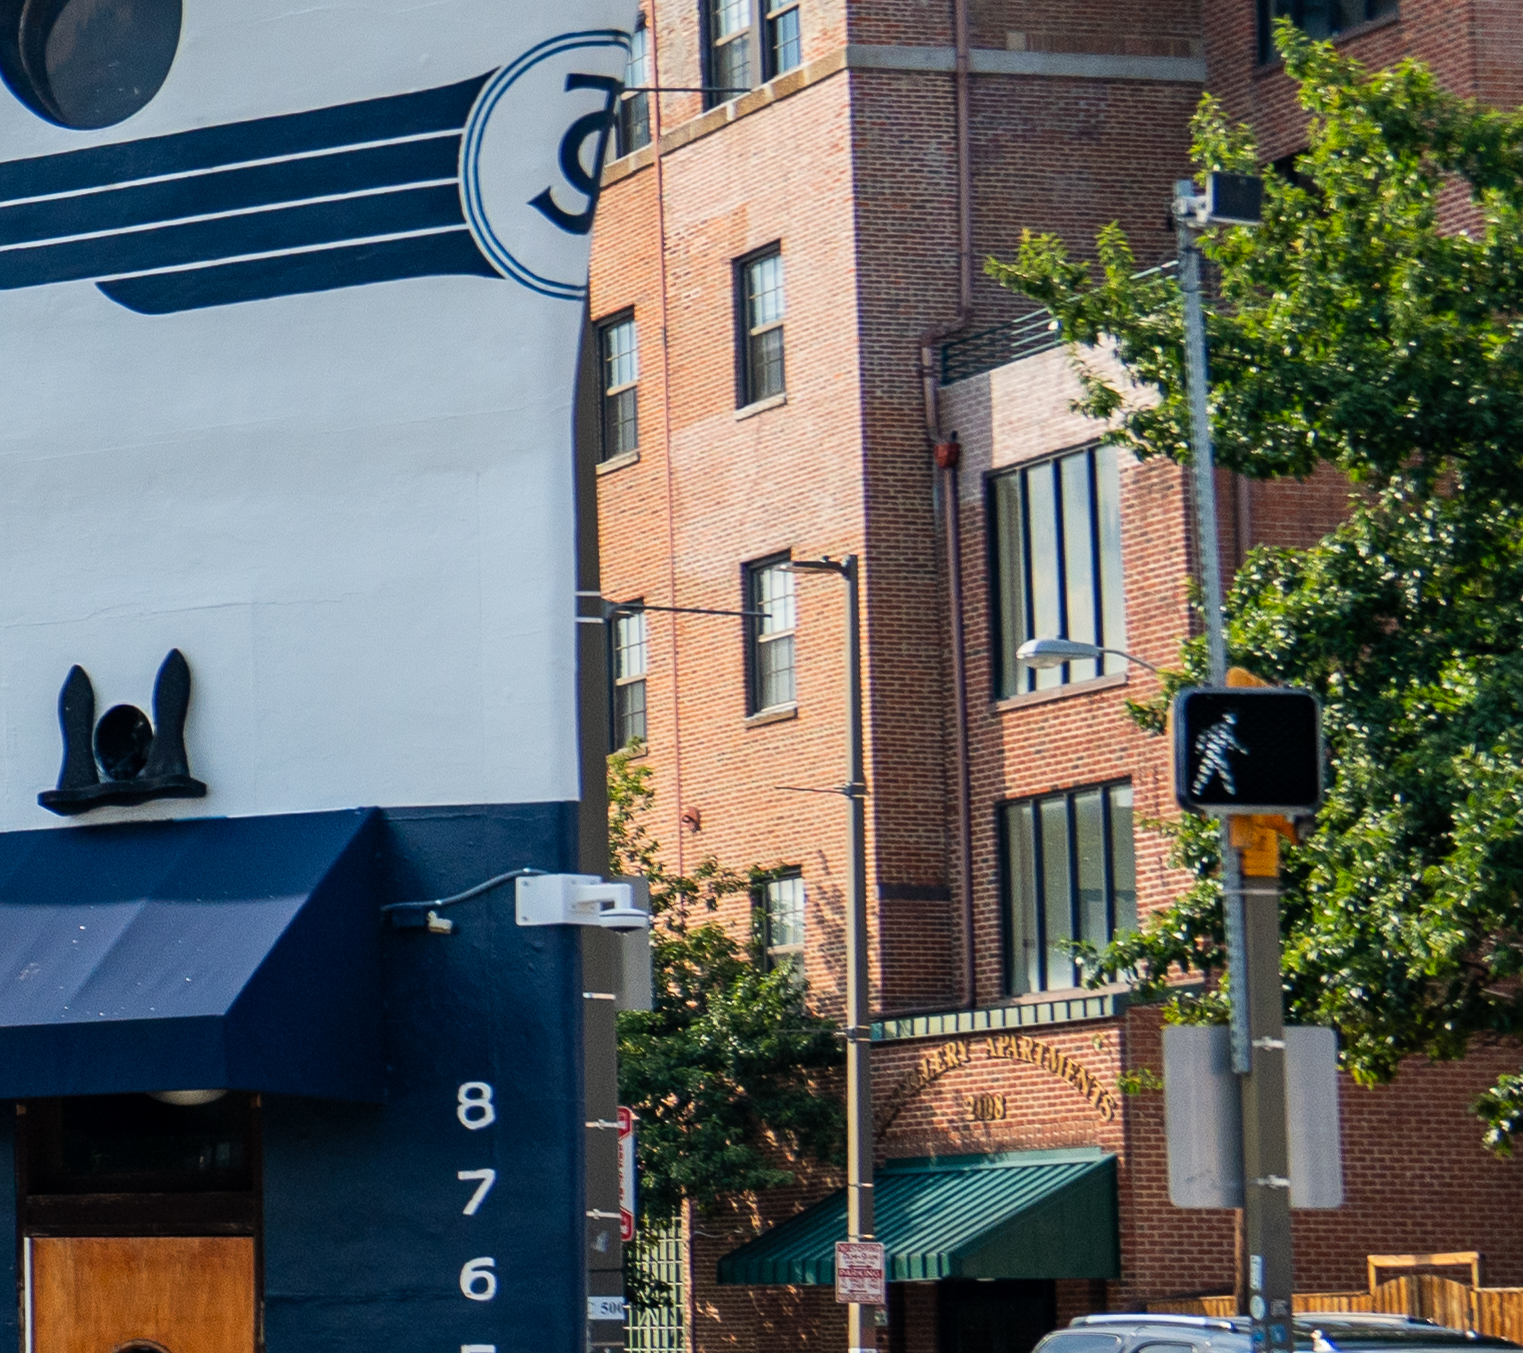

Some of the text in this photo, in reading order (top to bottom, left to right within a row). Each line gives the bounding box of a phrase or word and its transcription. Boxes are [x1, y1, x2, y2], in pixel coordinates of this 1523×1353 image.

[984, 1035, 1117, 1122] APARTMENTS
[457, 1081, 495, 1130] 8
[457, 1168, 496, 1215] 7
[460, 1257, 497, 1301] 6
